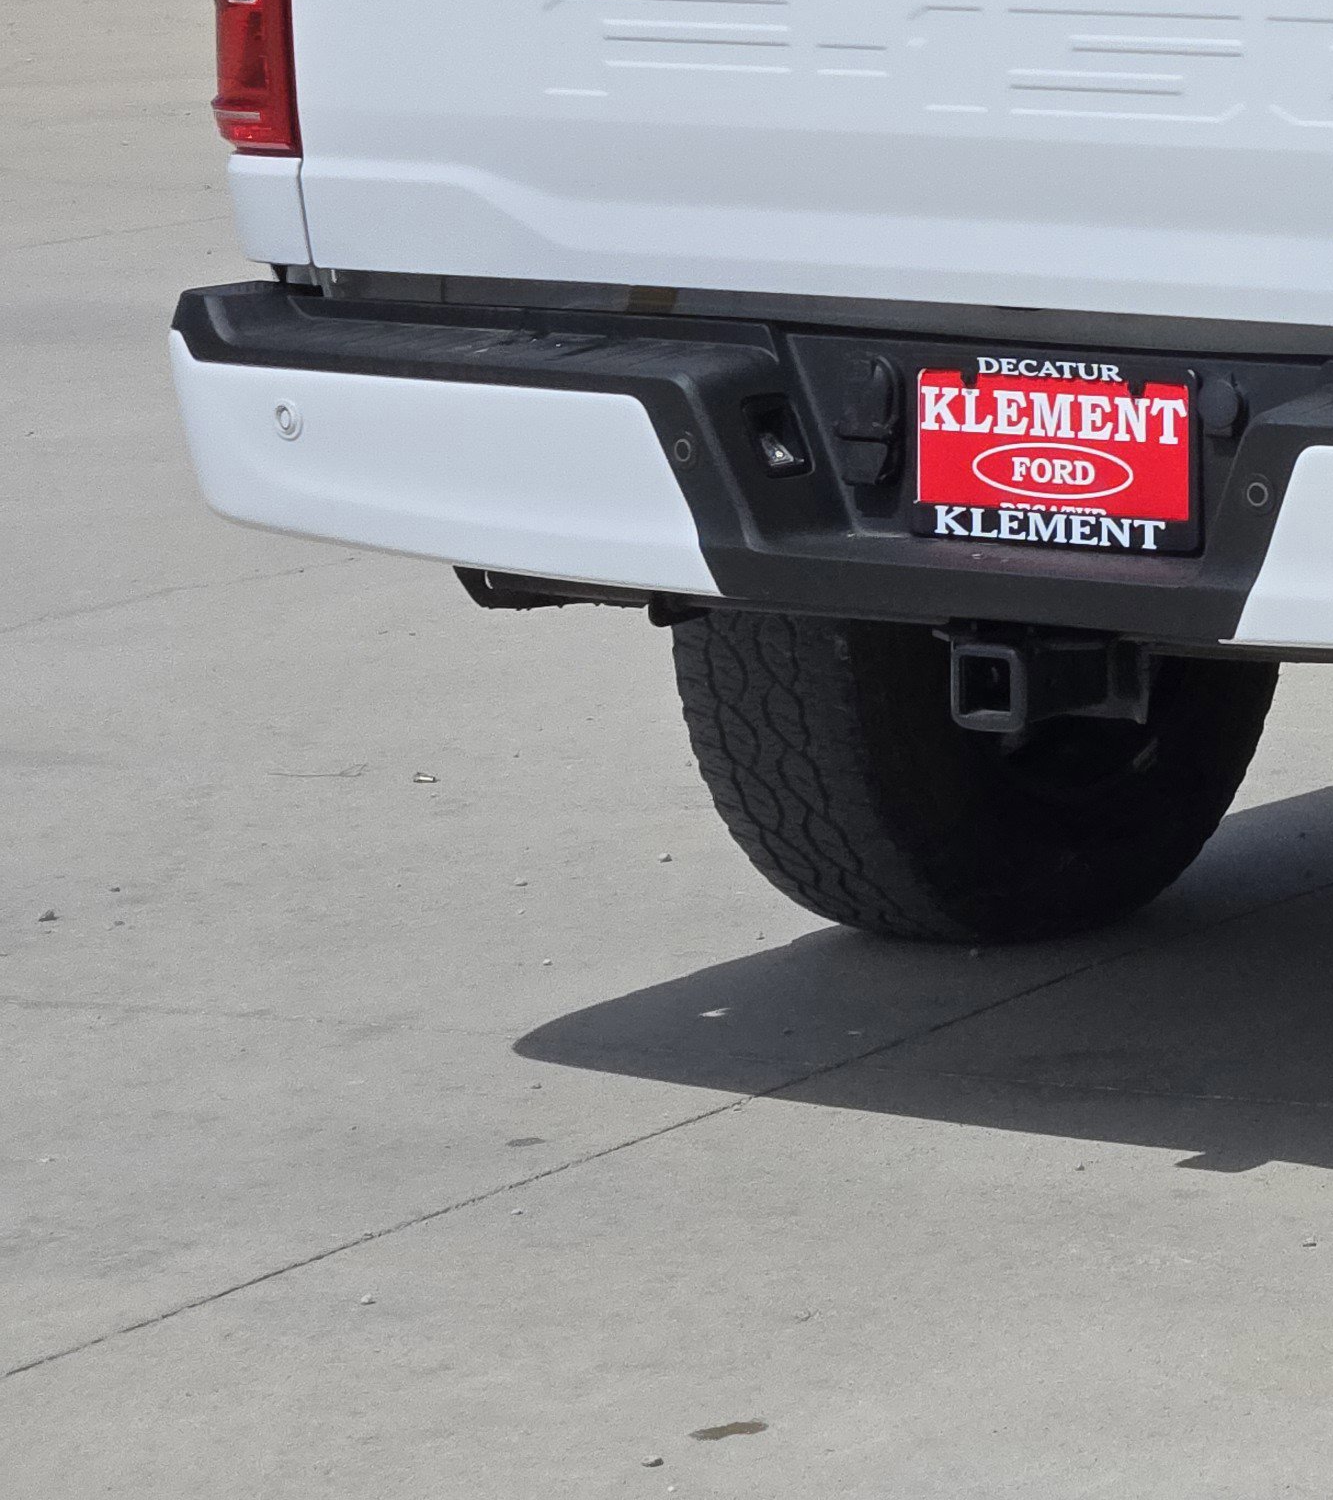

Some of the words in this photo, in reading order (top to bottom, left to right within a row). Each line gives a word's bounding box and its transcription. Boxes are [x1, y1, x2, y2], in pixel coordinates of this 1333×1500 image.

[977, 357, 1123, 382] DECATUR
[921, 386, 1187, 444] KLEMENT
[1011, 457, 1095, 486] FORD
[934, 505, 1166, 550] KLEMENT
